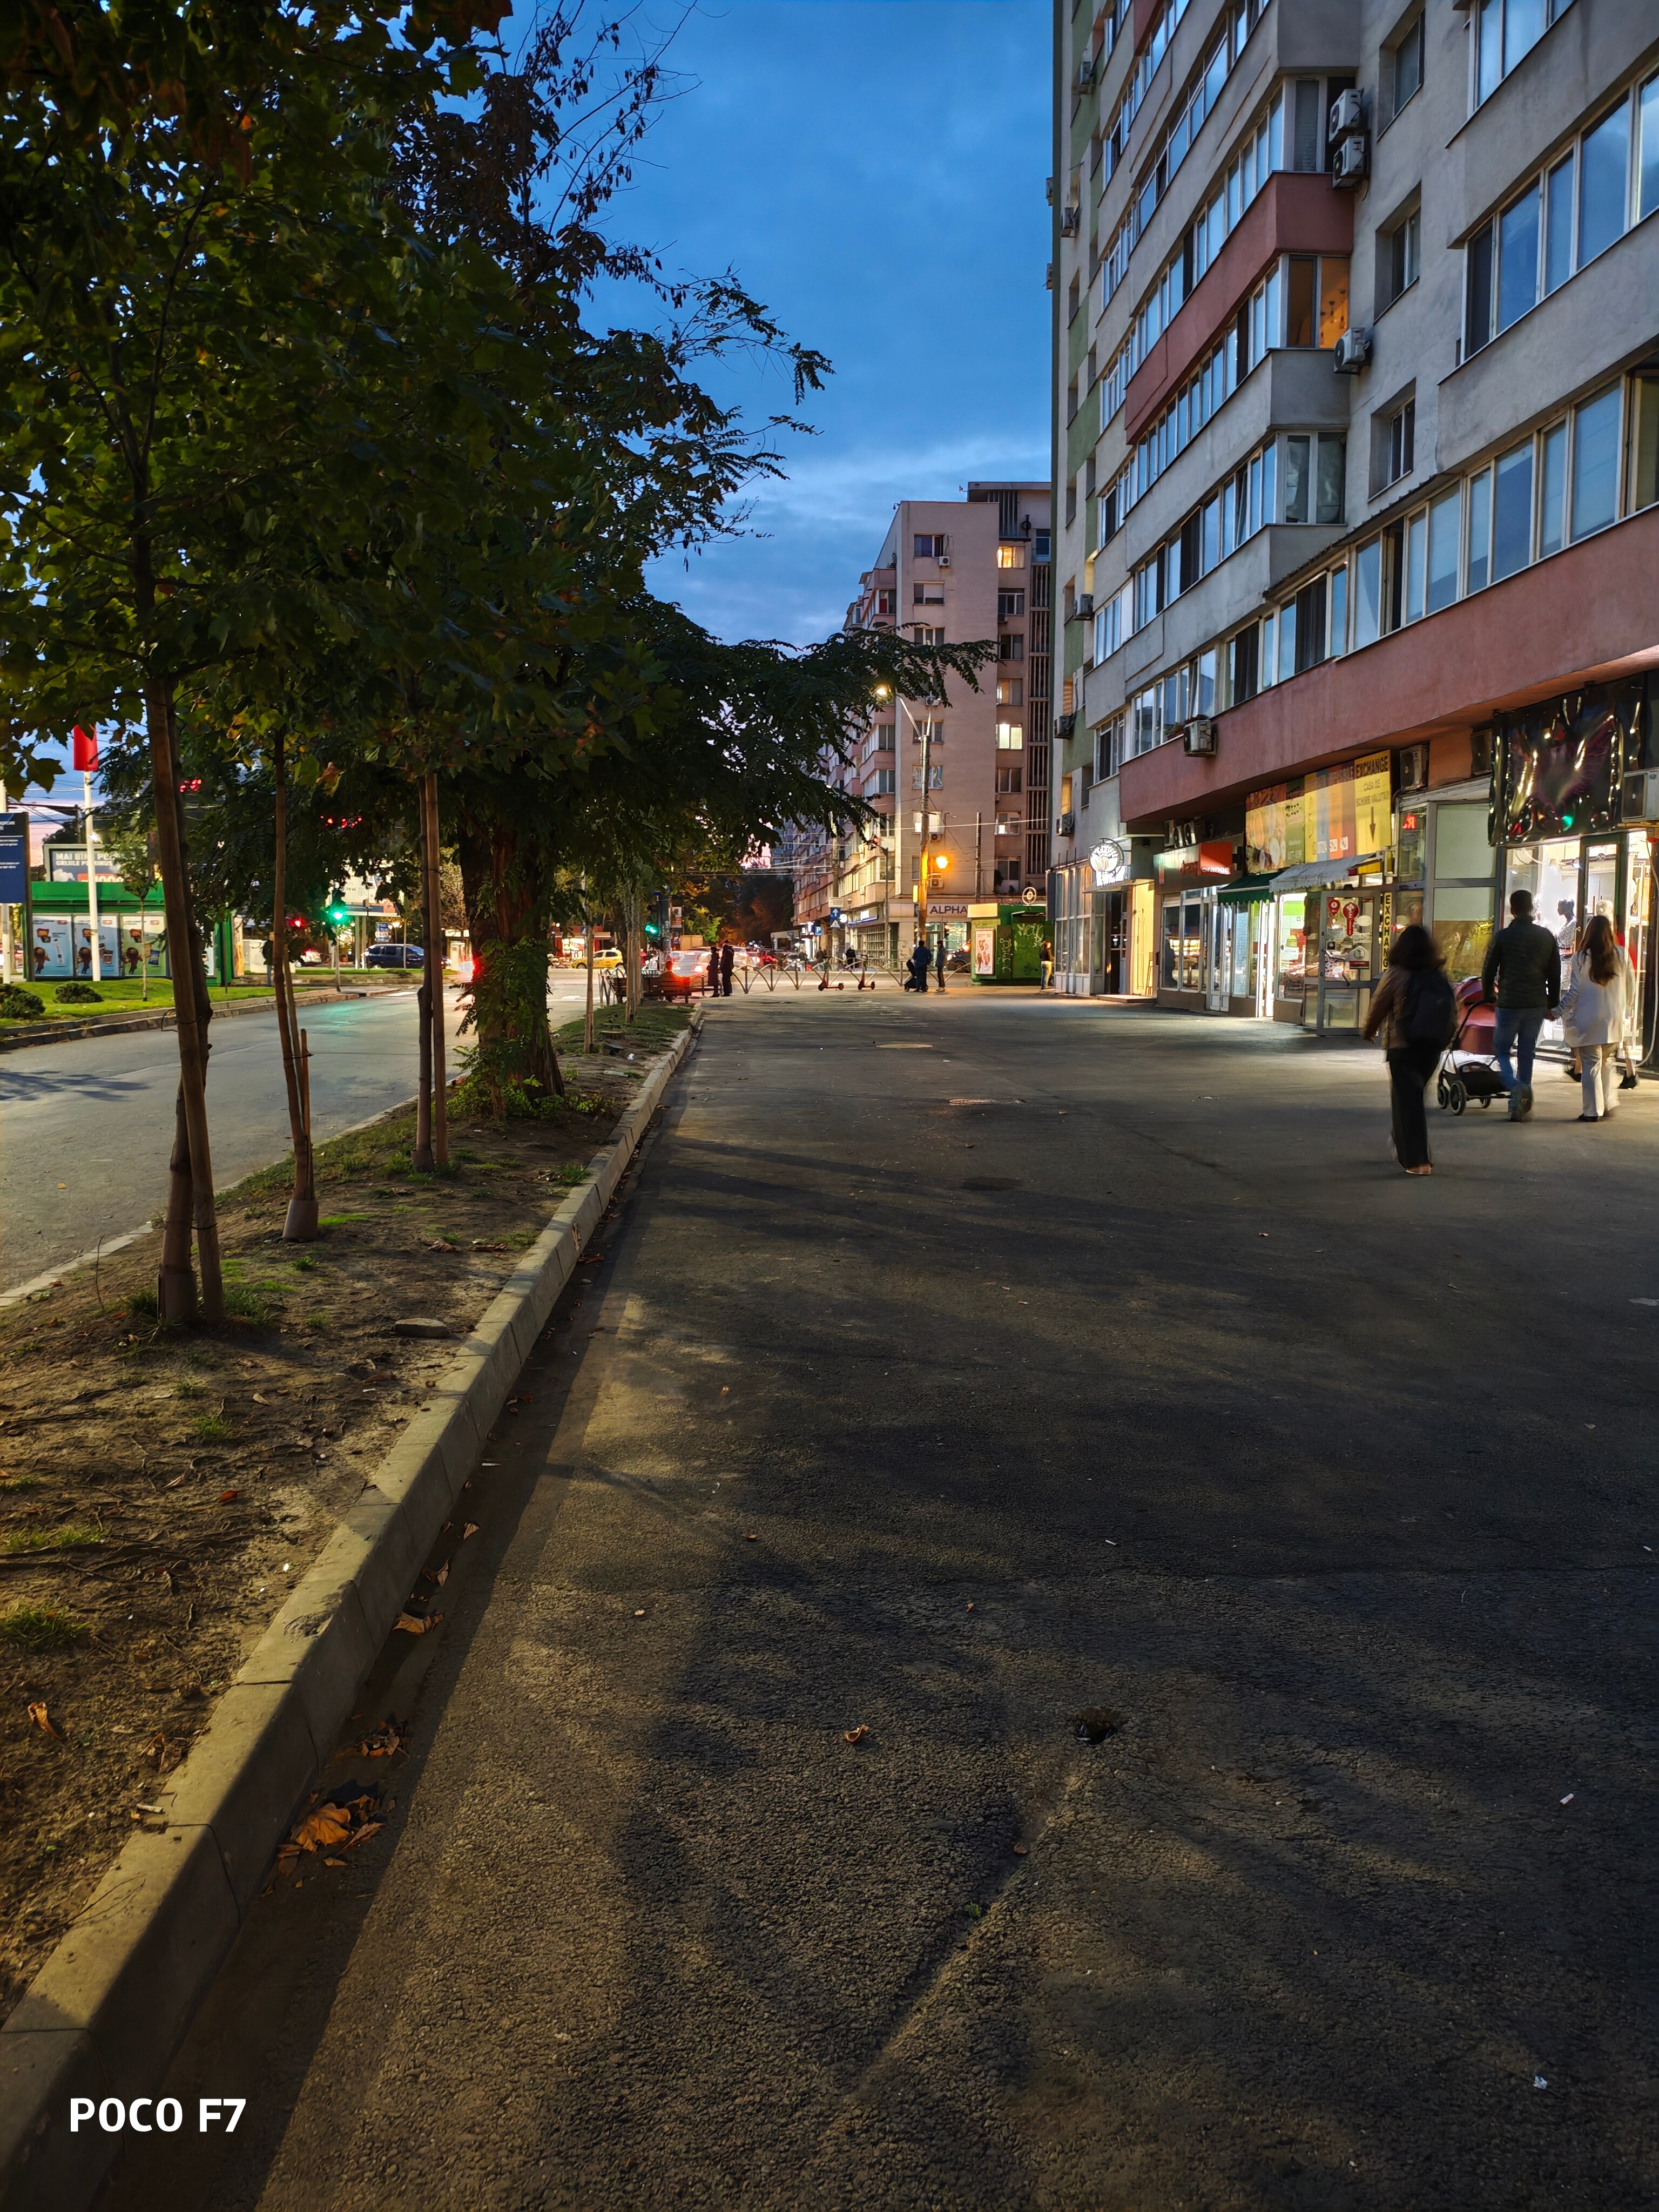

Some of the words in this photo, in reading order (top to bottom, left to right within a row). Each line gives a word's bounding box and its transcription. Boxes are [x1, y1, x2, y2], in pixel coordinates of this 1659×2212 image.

[1356, 756, 1388, 779] EXCHANGE
[1202, 866, 1231, 875] orange
[930, 906, 968, 914] ALPHA
